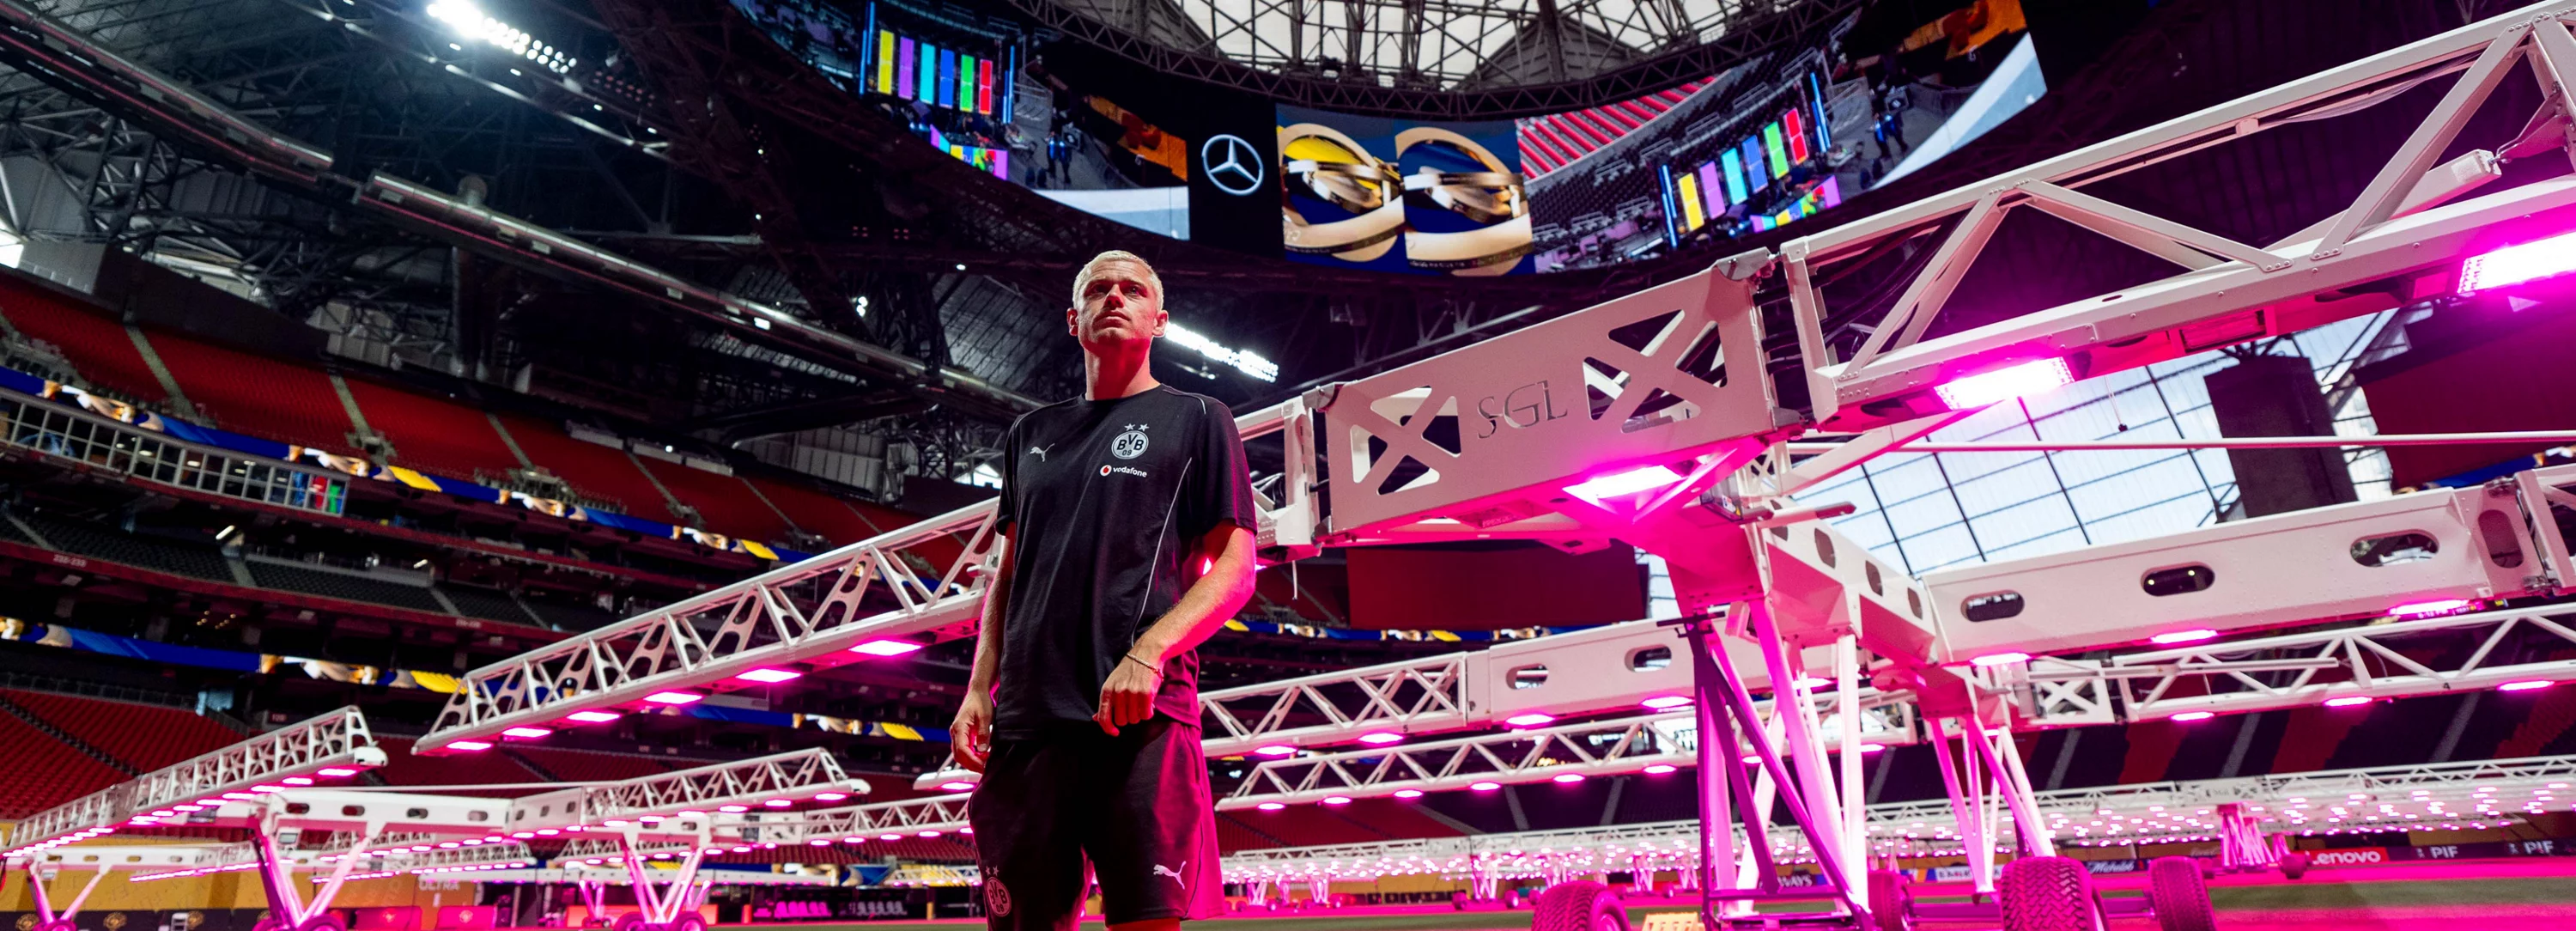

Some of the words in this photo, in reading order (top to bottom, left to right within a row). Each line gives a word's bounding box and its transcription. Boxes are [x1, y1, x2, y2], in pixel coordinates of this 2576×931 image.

[1478, 380, 1568, 439] SGL
[1116, 434, 1145, 451] BVB
[1113, 466, 1147, 478] vodafone
[2430, 845, 2458, 859] PIF
[2524, 840, 2554, 855] PIF
[988, 881, 1008, 904] BVB
